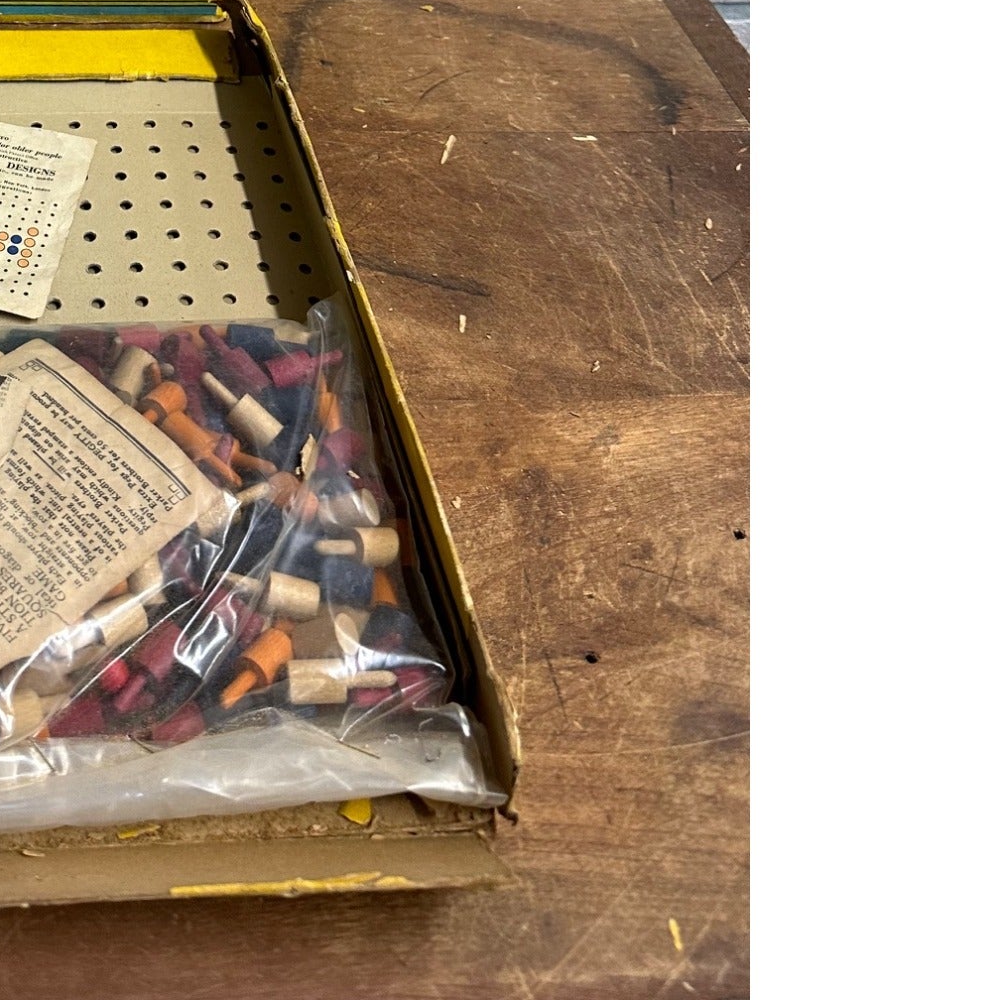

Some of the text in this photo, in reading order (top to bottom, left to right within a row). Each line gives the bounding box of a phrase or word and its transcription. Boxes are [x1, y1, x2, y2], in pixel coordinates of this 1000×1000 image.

[11, 144, 33, 153] older
[34, 149, 62, 160] people
[5, 161, 56, 177] DESIGNS
[48, 408, 59, 419] be
[67, 413, 82, 425] per
[58, 417, 75, 430] may
[79, 424, 97, 440] cents
[39, 425, 68, 450] stamped
[72, 431, 107, 461] PEGITY
[95, 439, 108, 450] 50
[16, 456, 33, 471] well
[106, 449, 121, 461] for
[4, 456, 26, 477] forms
[72, 454, 97, 477] enclose
[105, 459, 120, 472] for
[2, 466, 31, 492] playing
[21, 432, 129, 534] Parker Brothers will be pleased
[33, 472, 43, 480] as
[118, 460, 150, 489] Brothers
[118, 471, 137, 489] Pegs
[24, 475, 46, 497] which
[42, 438, 145, 536] questions which may arise on
[95, 476, 122, 502] Kindly
[28, 492, 42, 505] the
[69, 492, 87, 509] eyes.
[135, 487, 158, 509] Extra
[147, 488, 174, 512] Parker
[8, 512, 19, 521] at
[40, 504, 58, 520] that
[65, 501, 94, 529] playing
[125, 505, 152, 531] Pegity.
[137, 503, 159, 524] reply.
[1, 520, 28, 544] should
[56, 521, 75, 538] note
[61, 512, 88, 538] neutral
[38, 530, 56, 545] and
[52, 529, 63, 539] in
[61, 539, 77, 554] five
[73, 539, 97, 562] Please
[92, 530, 119, 556] various
[92, 544, 105, 555] of
[113, 537, 127, 551] the
[25, 543, 51, 566] player
[36, 540, 65, 568] straight
[74, 553, 90, 567] get
[53, 545, 91, 582] opponents
[87, 566, 98, 577] to
[22, 573, 36, 585] or
[46, 564, 67, 585] Each
[72, 578, 83, 588] in
[34, 587, 57, 609] tical
[3, 593, 37, 627] TION
[14, 622, 28, 634] A
